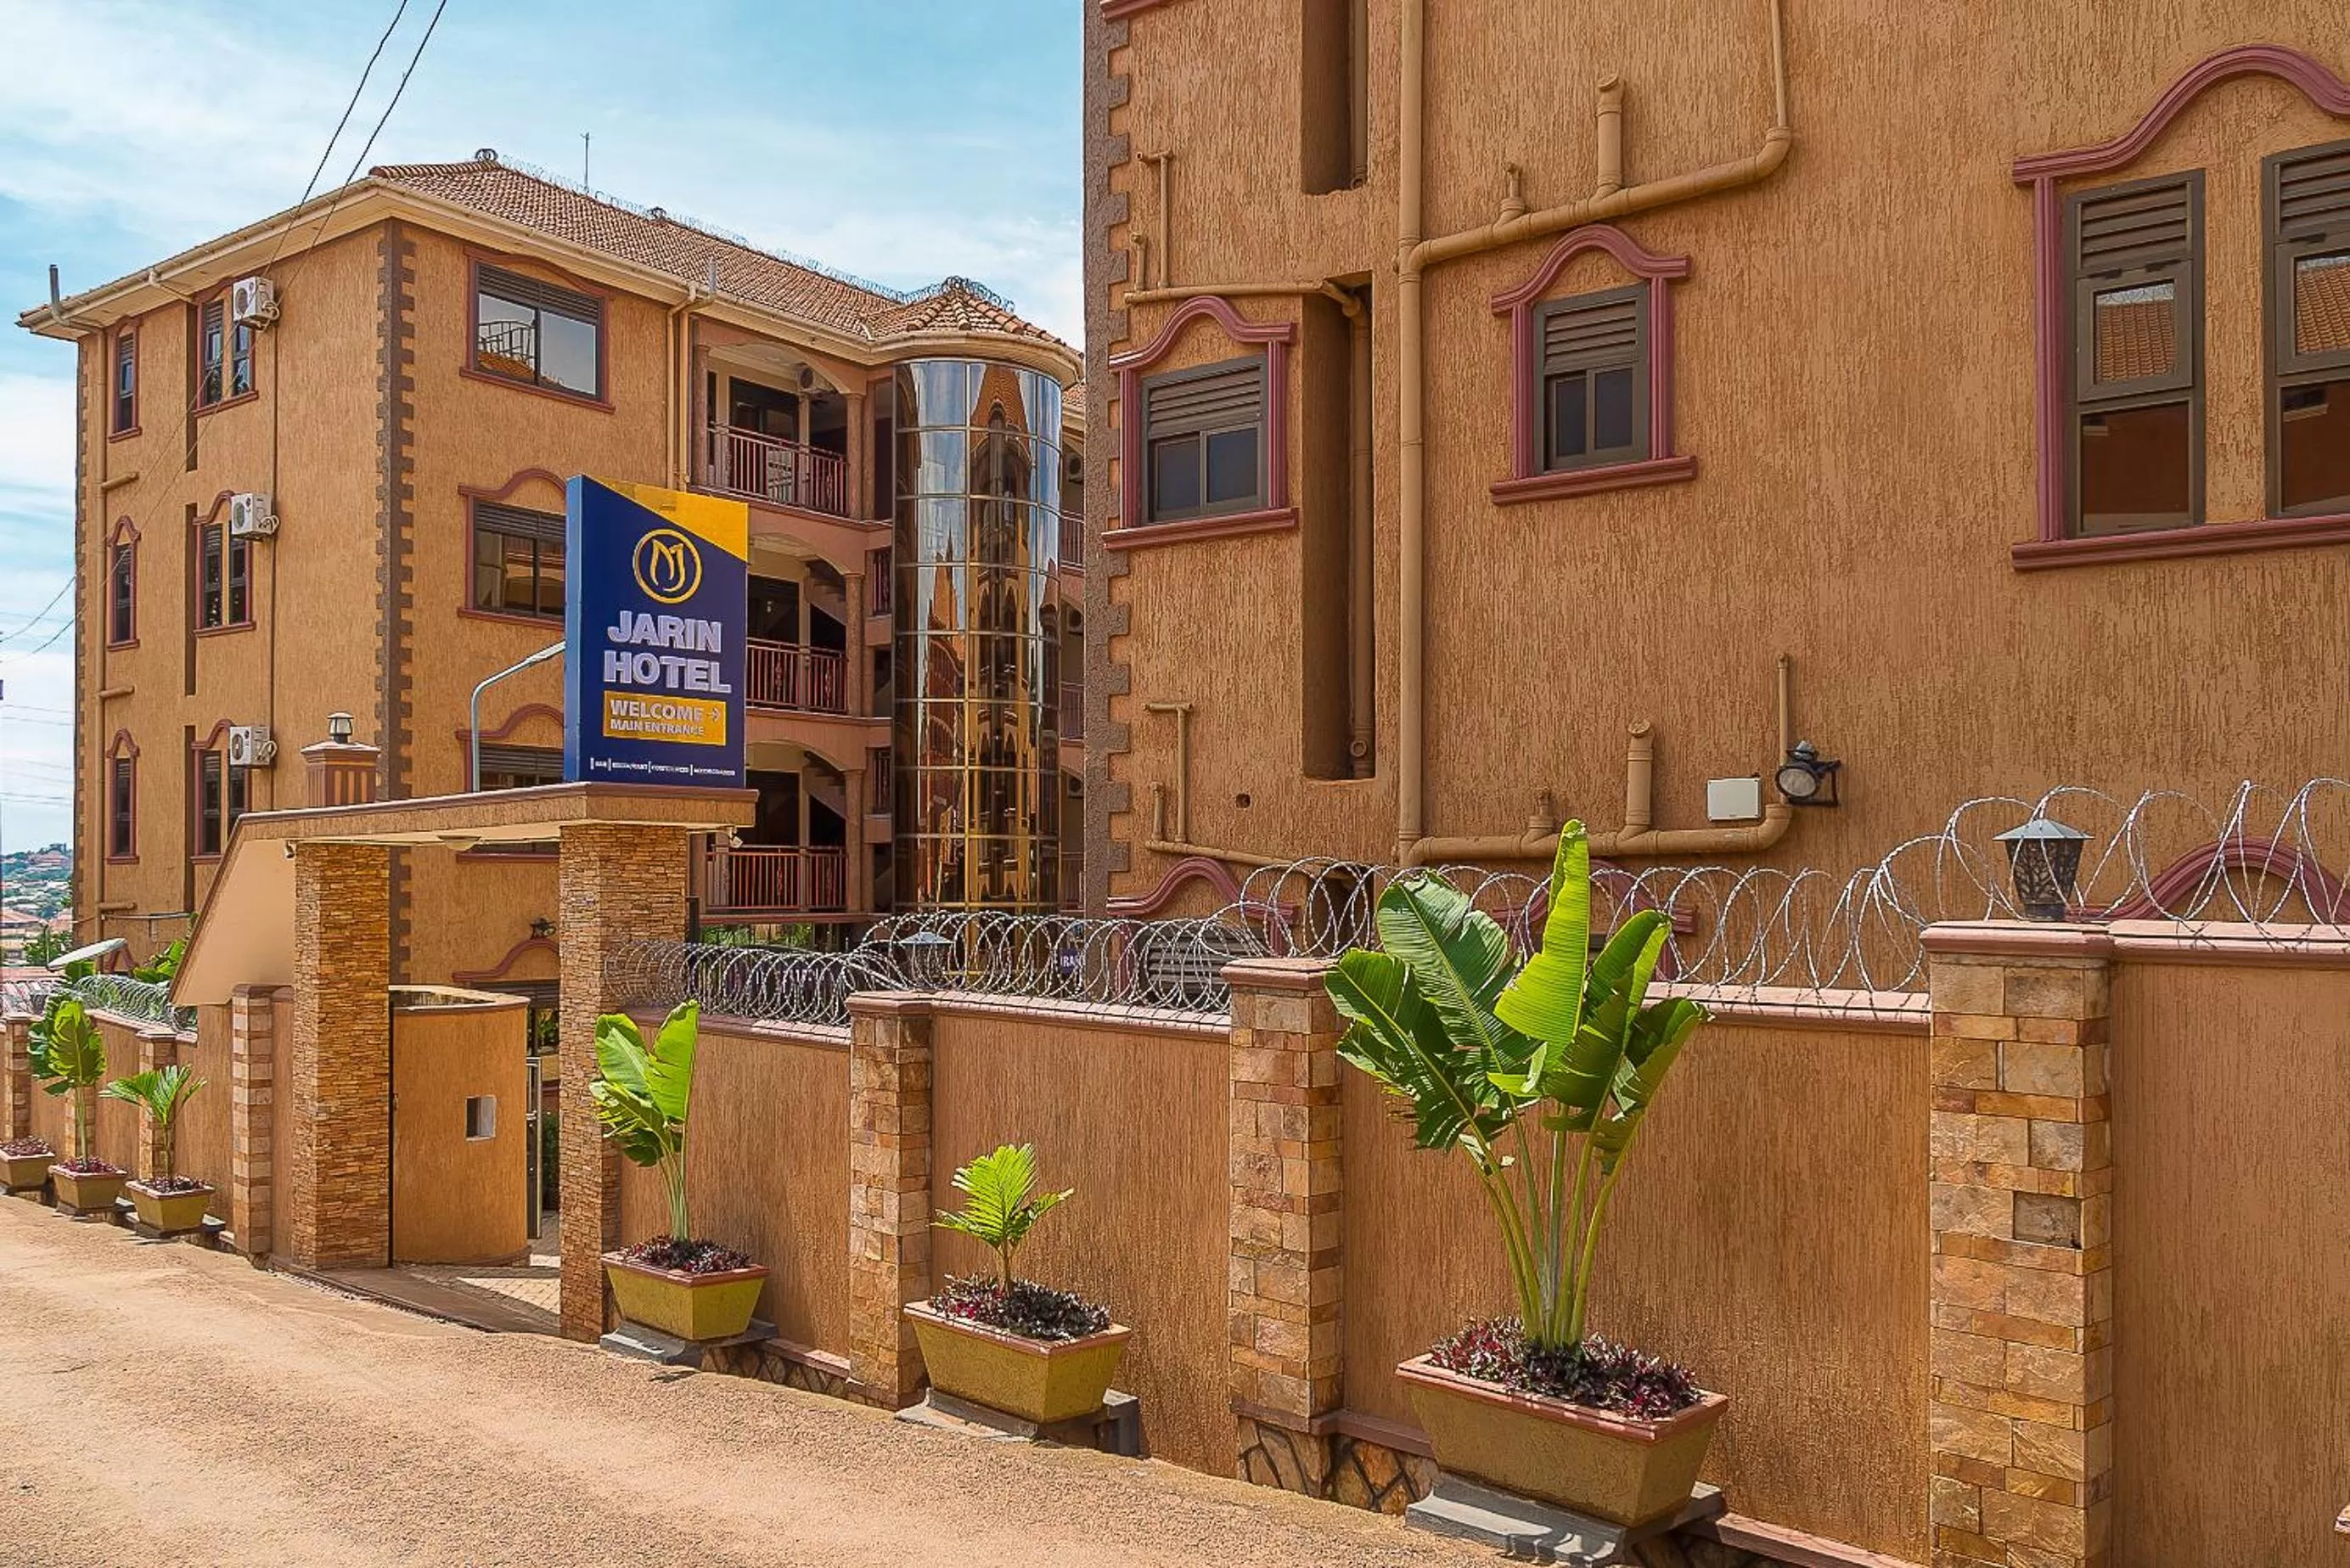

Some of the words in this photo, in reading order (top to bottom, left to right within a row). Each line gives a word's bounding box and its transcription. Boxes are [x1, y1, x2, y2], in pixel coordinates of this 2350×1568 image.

[607, 610, 722, 653] JARIN
[604, 649, 732, 694] HOTEL
[610, 699, 704, 722] WELCOME
[610, 719, 643, 732] MAIN
[644, 722, 704, 736] ENTRANCE
